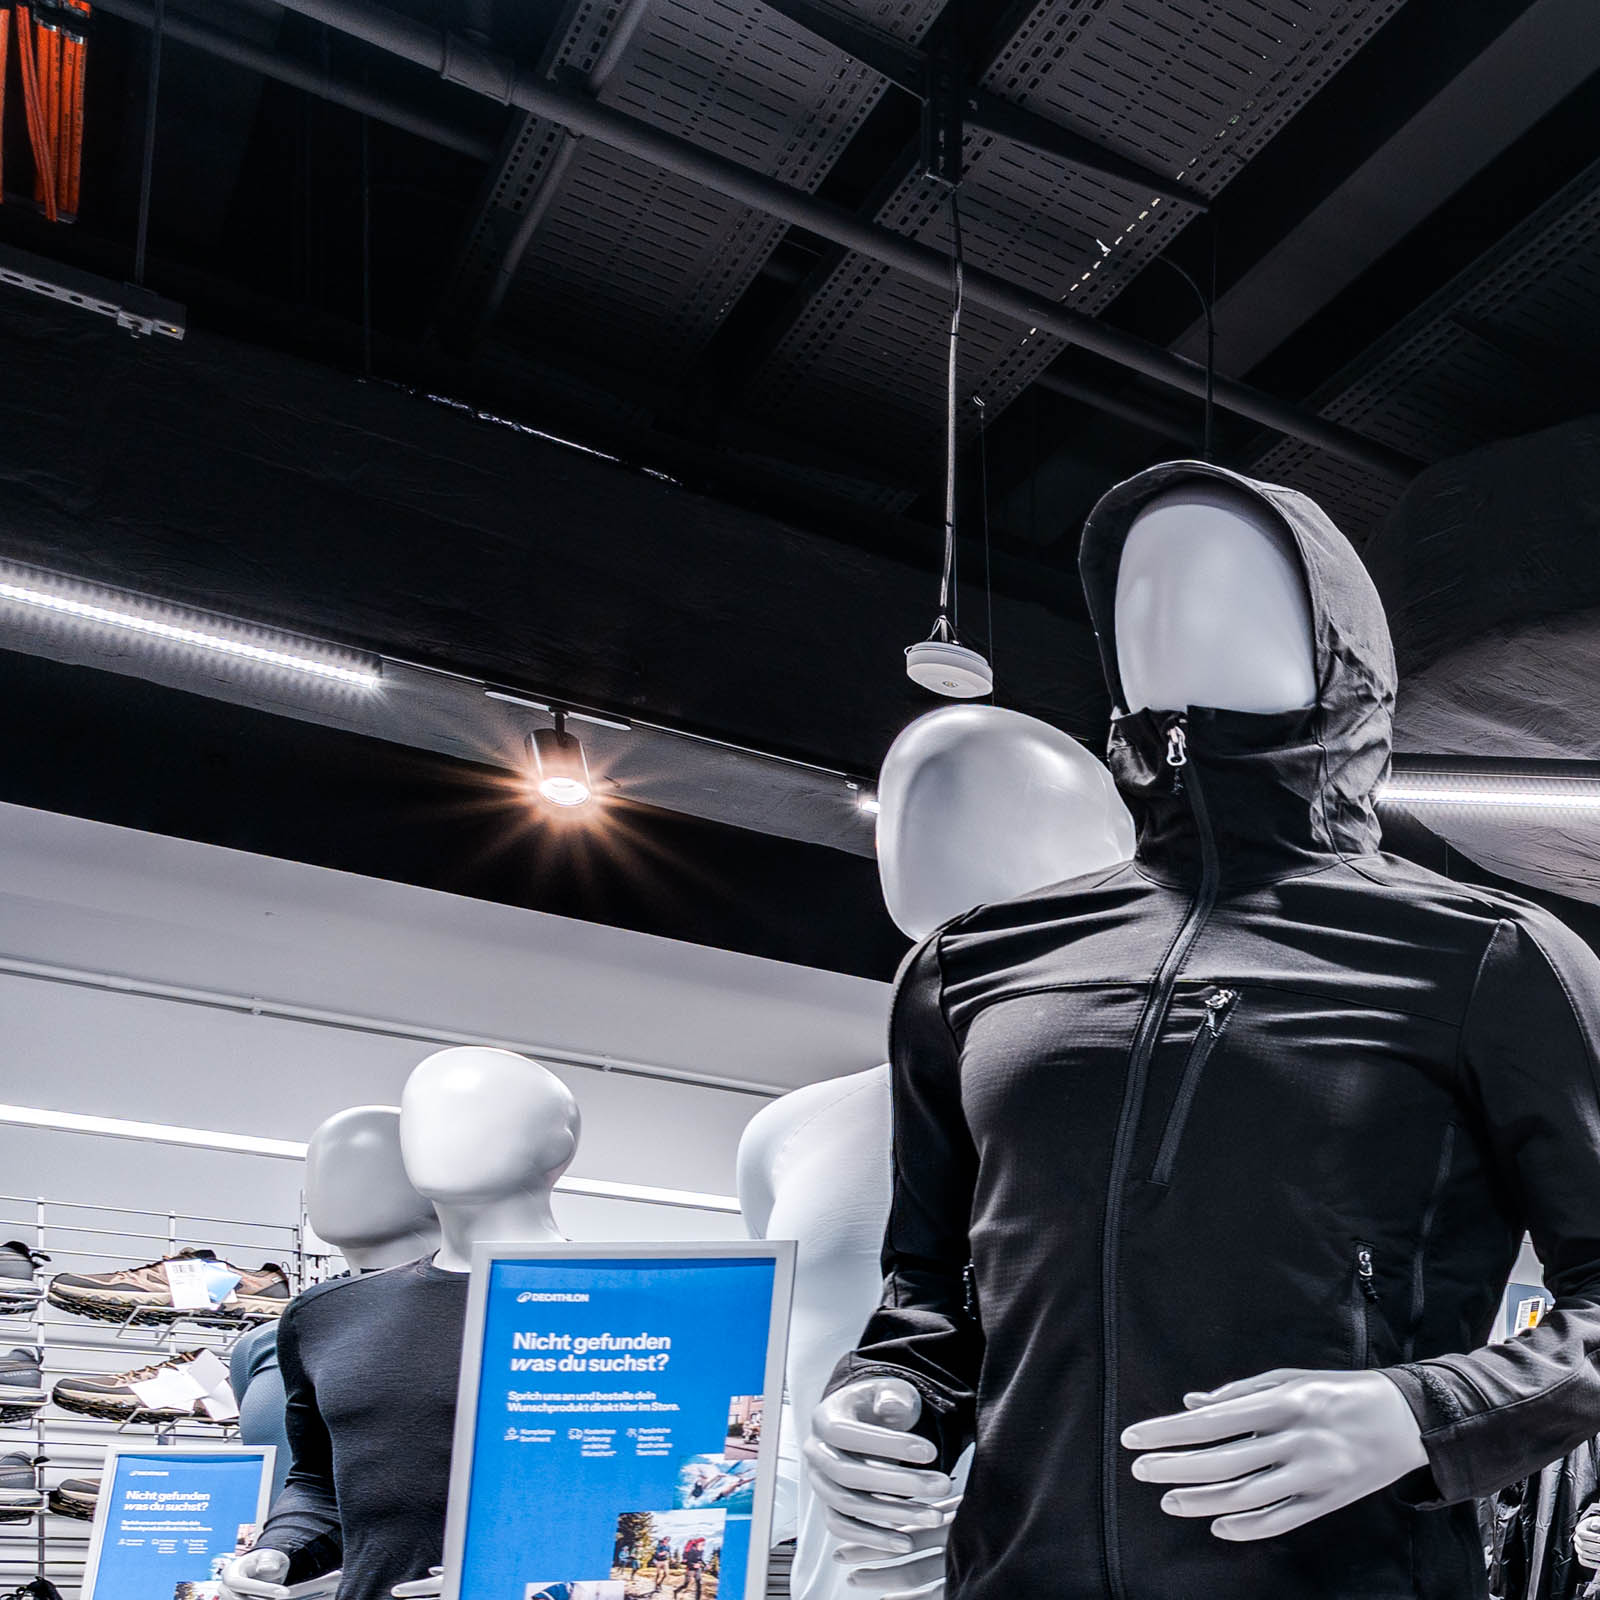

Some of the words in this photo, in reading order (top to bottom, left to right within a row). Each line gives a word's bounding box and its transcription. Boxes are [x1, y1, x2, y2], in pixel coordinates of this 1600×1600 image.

[530, 1293, 590, 1303] DECATHLON
[513, 1332, 572, 1350] Nicht
[573, 1333, 671, 1355] gefunden
[510, 1358, 557, 1372] was
[558, 1354, 586, 1372] du
[588, 1354, 670, 1372] suchst?
[508, 1391, 542, 1402] Sprich
[576, 1391, 595, 1401] und
[595, 1391, 633, 1401] bestelle
[507, 1402, 590, 1414] Wunschprodukt
[590, 1402, 619, 1411] direkt
[619, 1402, 638, 1411] hier
[126, 1490, 157, 1500] Nicht
[158, 1491, 210, 1502] gefunden
[124, 1503, 148, 1511] was
[149, 1502, 164, 1511] du
[165, 1502, 209, 1511] suchst?
